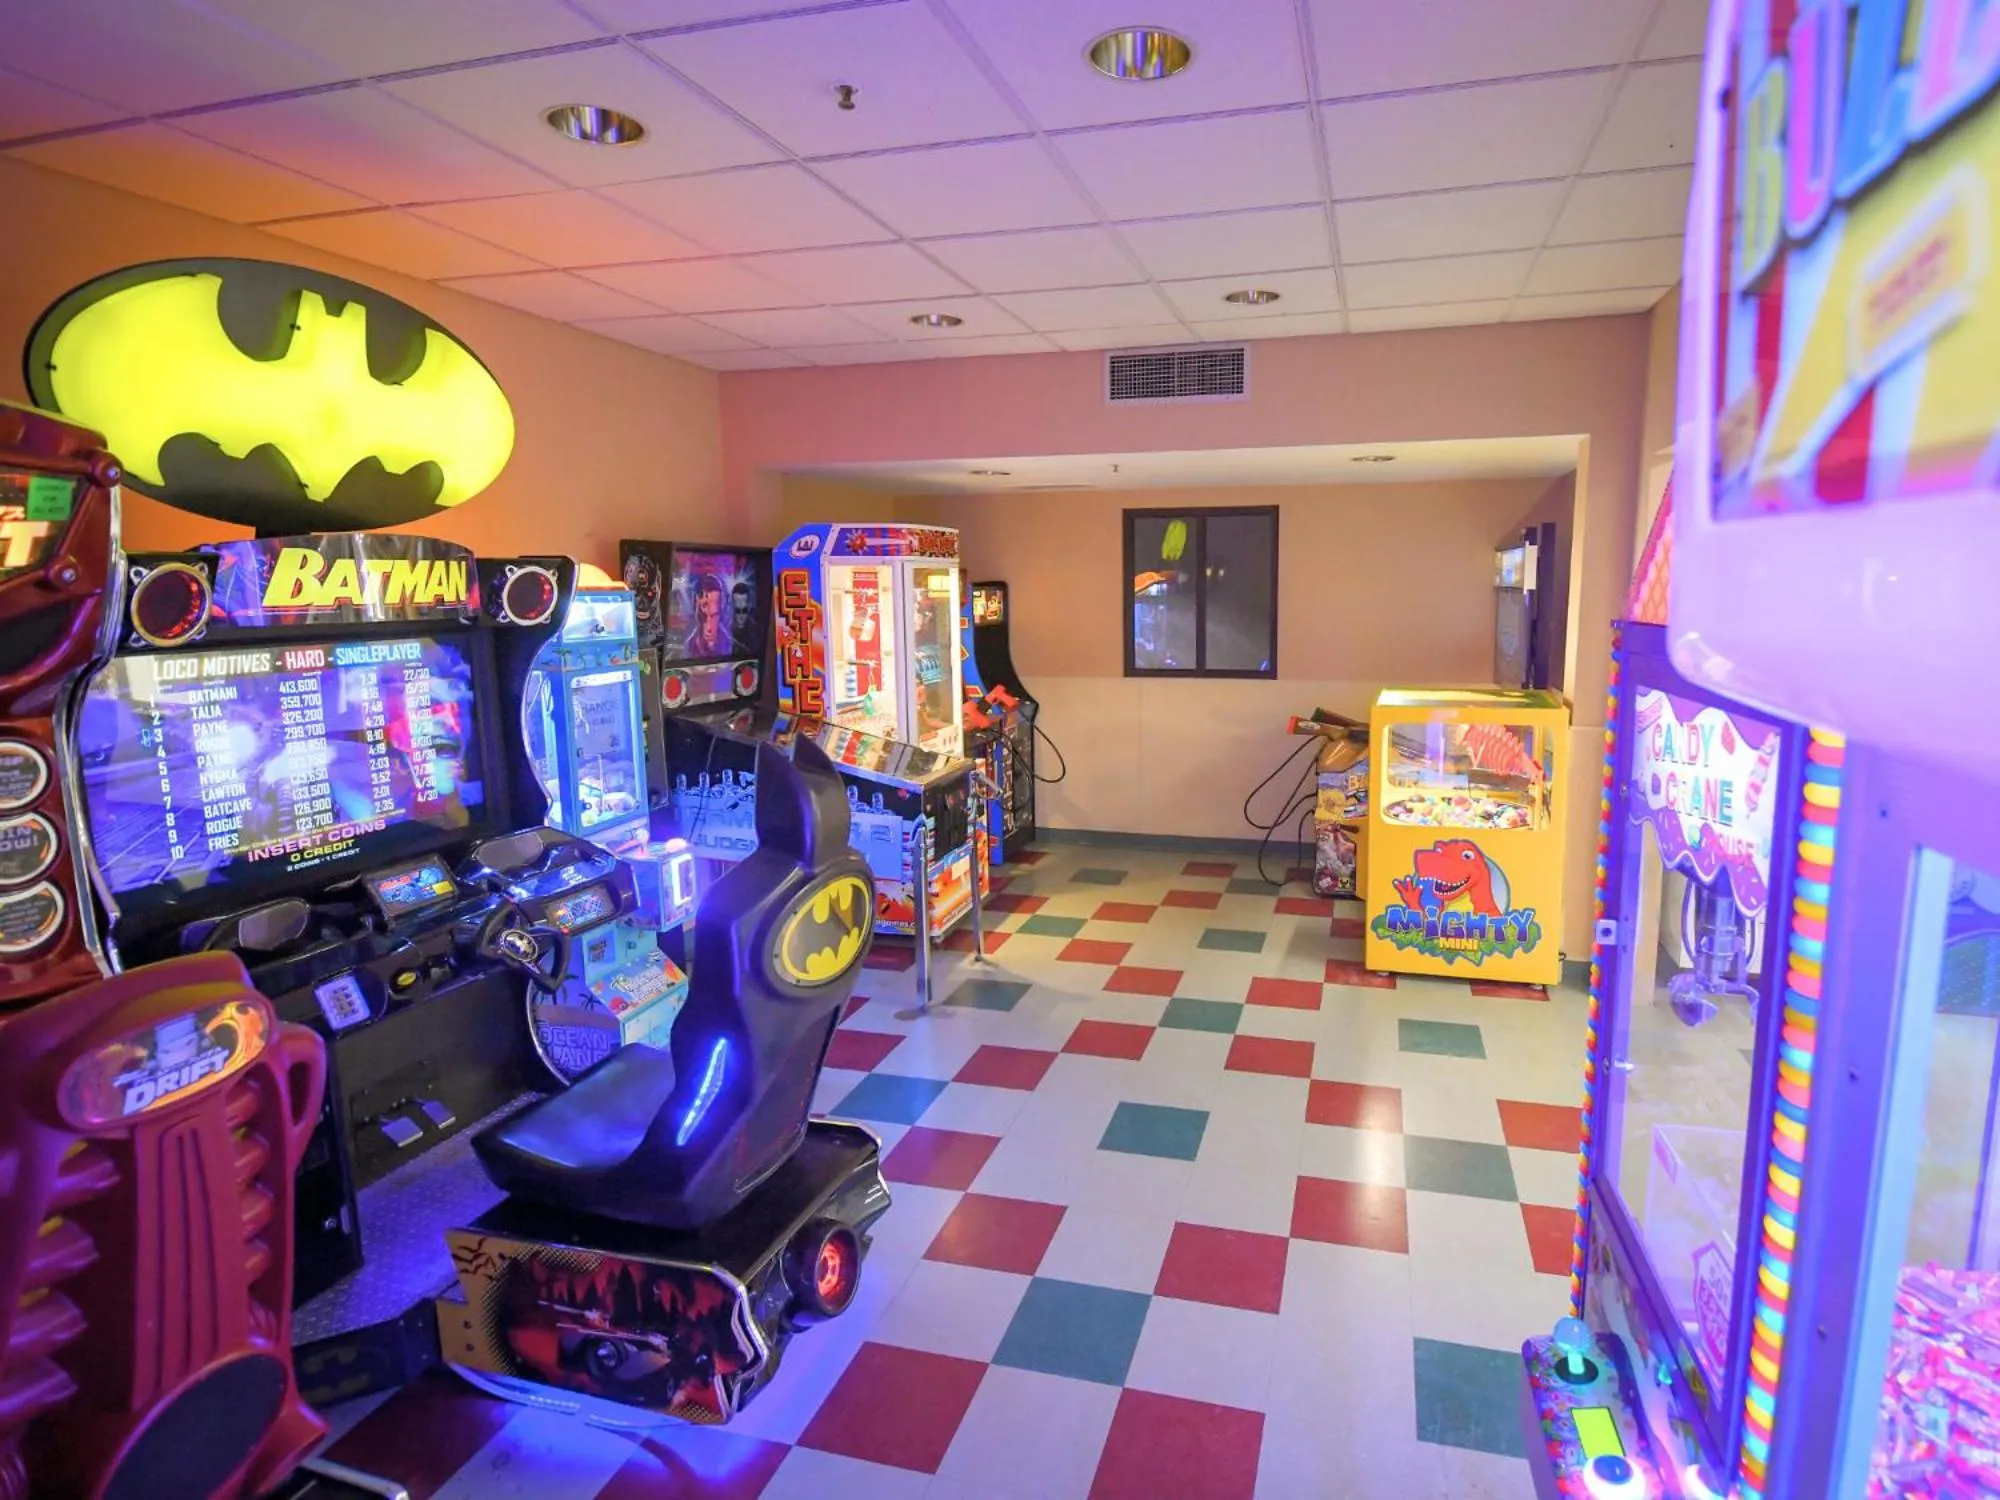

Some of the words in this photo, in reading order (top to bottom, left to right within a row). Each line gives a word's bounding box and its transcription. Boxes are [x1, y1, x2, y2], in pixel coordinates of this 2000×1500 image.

[262, 547, 469, 608] BATMAN
[781, 571, 824, 716] STAC
[153, 658, 198, 681] LOCO
[203, 653, 271, 677] MOTIVES
[285, 649, 325, 670] HARD
[336, 643, 422, 665] SINGLEPLAYER
[152, 711, 160, 726] 2
[192, 705, 222, 720] TALIA
[154, 728, 163, 742] 3
[193, 720, 229, 737] PAYNE
[1652, 722, 1715, 766] CANDY
[157, 745, 166, 759] 4
[158, 762, 167, 775] 5
[161, 779, 170, 793] 6
[164, 796, 172, 810] 7
[202, 783, 246, 799] LAWTON
[1666, 772, 1734, 827] CRANE
[166, 813, 175, 827] 8
[204, 798, 252, 819] BATCAVE
[168, 829, 177, 843] 9
[206, 816, 243, 835] ROGUE
[248, 834, 323, 862] INSERT
[328, 819, 386, 842] COINS
[171, 845, 184, 860] 10
[208, 834, 239, 851] FRIES
[303, 839, 355, 860] CREDIT
[331, 848, 360, 860] CREDIT
[1387, 905, 1534, 943] MiGHTY
[1439, 936, 1480, 951] MINI
[539, 1027, 609, 1050] OCEAN
[123, 1049, 229, 1116] DRIFT
